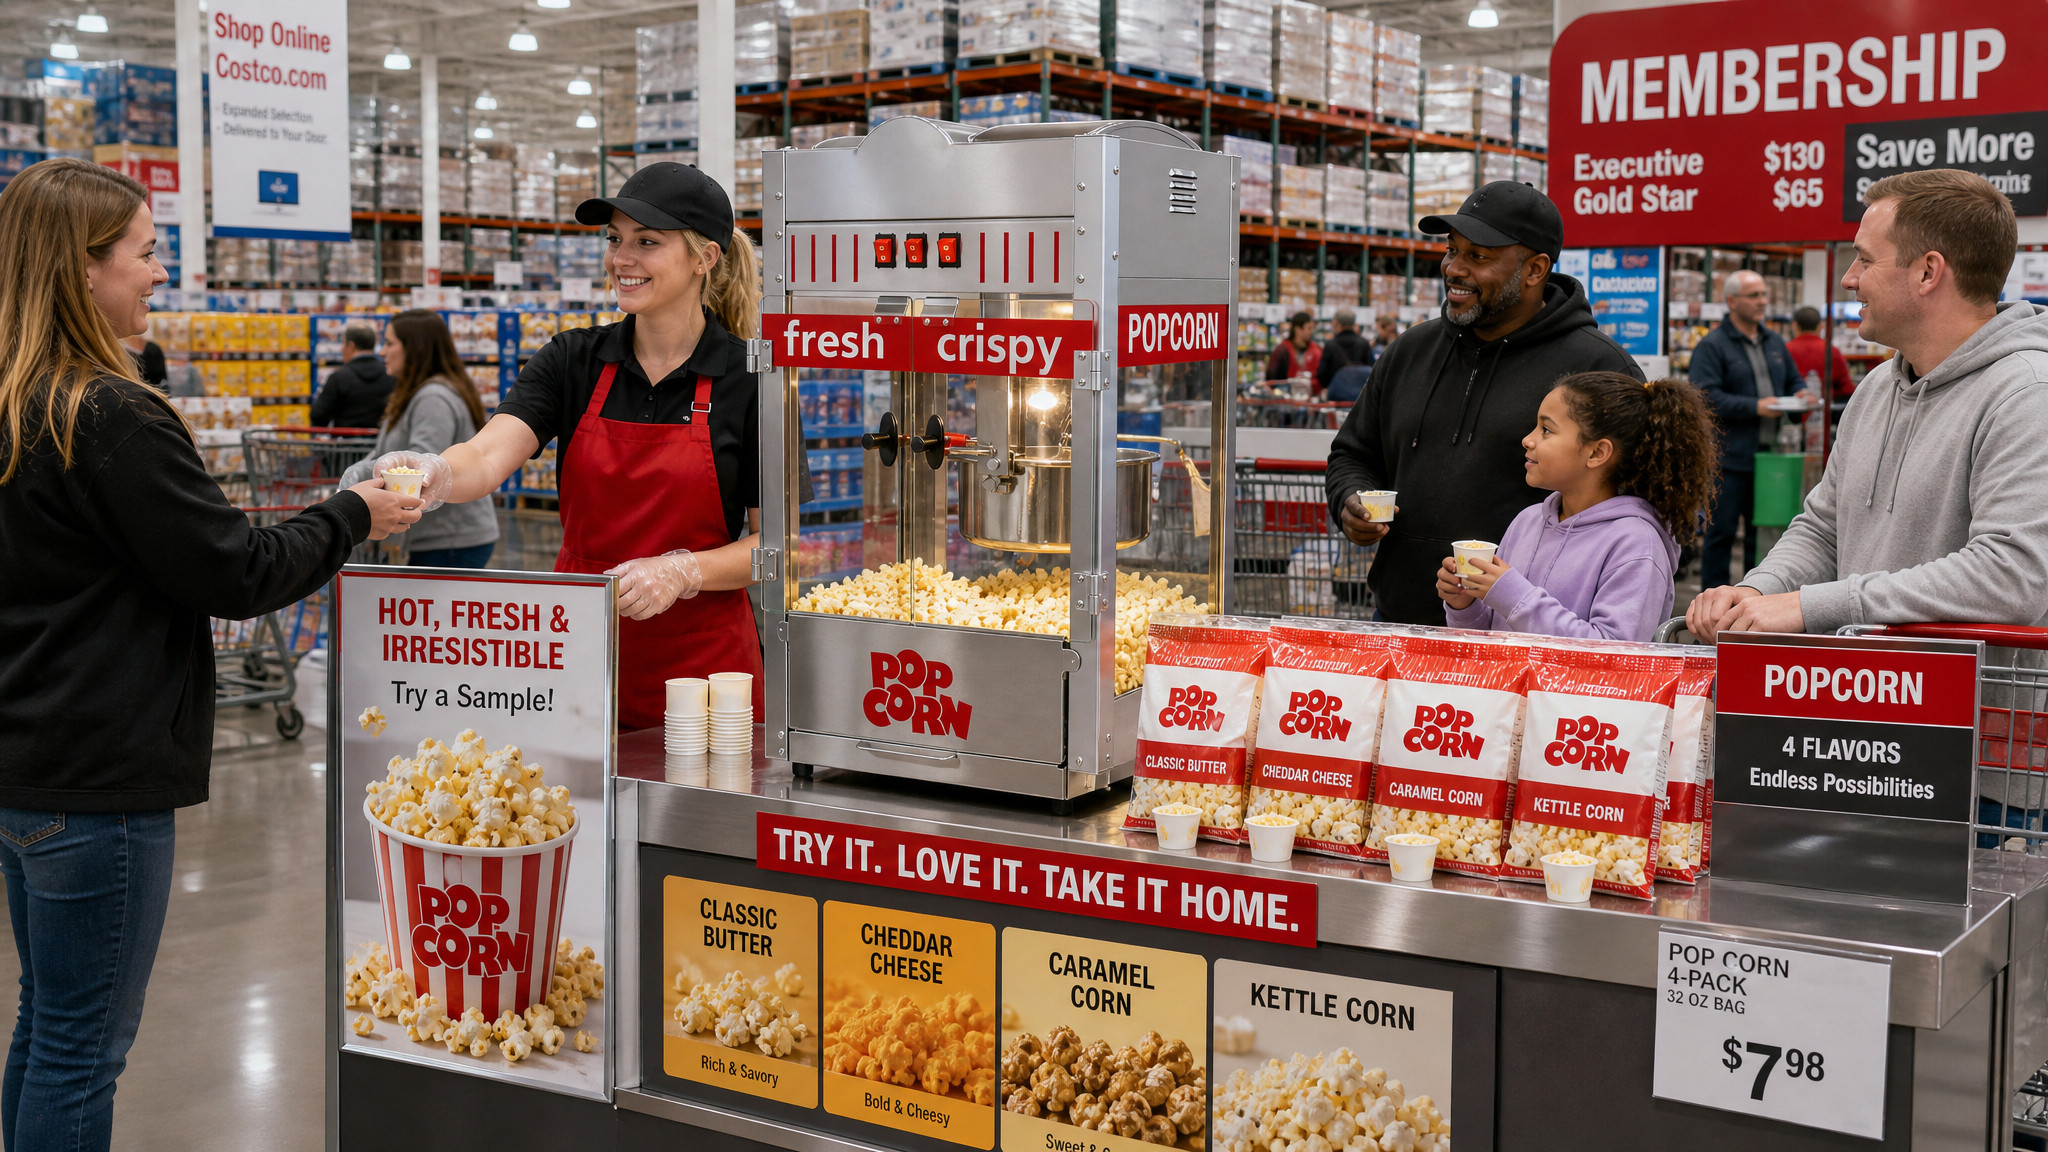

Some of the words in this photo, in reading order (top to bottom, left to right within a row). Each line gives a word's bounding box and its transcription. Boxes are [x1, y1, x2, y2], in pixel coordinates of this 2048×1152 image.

[215, 12, 263, 48] Shop
[271, 22, 330, 53] Online
[216, 53, 327, 90] Costco.com
[1581, 28, 2006, 124] MEMBERSHIP
[223, 122, 267, 139] Delivered
[270, 128, 279, 140] to
[282, 128, 302, 142] Your
[1856, 133, 1936, 169] Save
[1946, 127, 2035, 164] More
[1574, 148, 1704, 182] Executive
[1764, 140, 1825, 176] $130
[1573, 185, 1633, 215] Gold
[1641, 184, 1698, 213] Star
[1773, 176, 1824, 212] $65
[783, 320, 884, 359] fresh
[937, 322, 1062, 375] crispy
[1127, 312, 1219, 354] POPCORN
[378, 597, 440, 632] HOT,
[451, 600, 540, 632] FRESH
[550, 604, 570, 633] &
[383, 634, 564, 670] IRRESISTIBLE
[870, 649, 953, 698] POP
[1764, 664, 1923, 705] POPCORN
[391, 680, 428, 712] Try
[435, 689, 449, 706] a
[457, 683, 554, 717] Sample!
[863, 683, 973, 741] CORN
[1168, 684, 1217, 711] POP
[1288, 689, 1343, 717] POP
[1158, 704, 1225, 733] CORN
[1279, 710, 1352, 743] CORN
[1414, 702, 1474, 733] POP
[1555, 715, 1619, 746] POP
[1403, 724, 1485, 761] CORN
[1543, 738, 1630, 775] CORN
[1781, 736, 1796, 758] 4
[1803, 737, 1901, 765] FLAVORS
[1145, 755, 1185, 770] CLASSIC
[1187, 759, 1227, 774] BUTTER
[1262, 764, 1309, 783] CHEDDAR
[1312, 770, 1353, 788] CHEESE
[1389, 781, 1445, 802] CARAMEL
[1448, 789, 1483, 807] CORN
[1750, 767, 1818, 791] Endless
[1823, 772, 1935, 800] Possibilities
[1533, 796, 1582, 817] KETTLE
[1585, 803, 1624, 823] CORN
[773, 827, 834, 866] TRY
[845, 837, 882, 873] IT.
[898, 844, 981, 888] LOVE
[993, 857, 1028, 894] IT.
[1039, 863, 1125, 908] TAKE
[1137, 876, 1168, 913] IT
[1181, 881, 1299, 932] HOME.
[417, 883, 510, 935] POP
[700, 897, 777, 930] CLASSIC
[411, 923, 529, 978] CORN
[703, 925, 773, 958] BUTTER
[861, 923, 953, 958] CHEDDAR
[870, 952, 943, 985] CHEESE
[1049, 951, 1155, 990] CARAMEL
[1669, 942, 1715, 966] POP
[1722, 951, 1790, 979] CORN
[1667, 966, 1747, 997] 4-PACK
[1070, 984, 1131, 1016] CORN
[1250, 982, 1338, 1019] KETTLE
[1346, 997, 1415, 1032] CORN
[1667, 989, 1684, 1004] 32
[1688, 992, 1708, 1008] OZ
[1714, 996, 1745, 1015] BAG
[701, 1054, 725, 1074] Rich
[728, 1061, 737, 1076] &
[740, 1064, 779, 1089] Savory
[864, 1092, 890, 1112] Bold
[894, 1099, 903, 1115] &
[906, 1102, 951, 1129] Cheesy
[1046, 1133, 1085, 1152] Sweet
